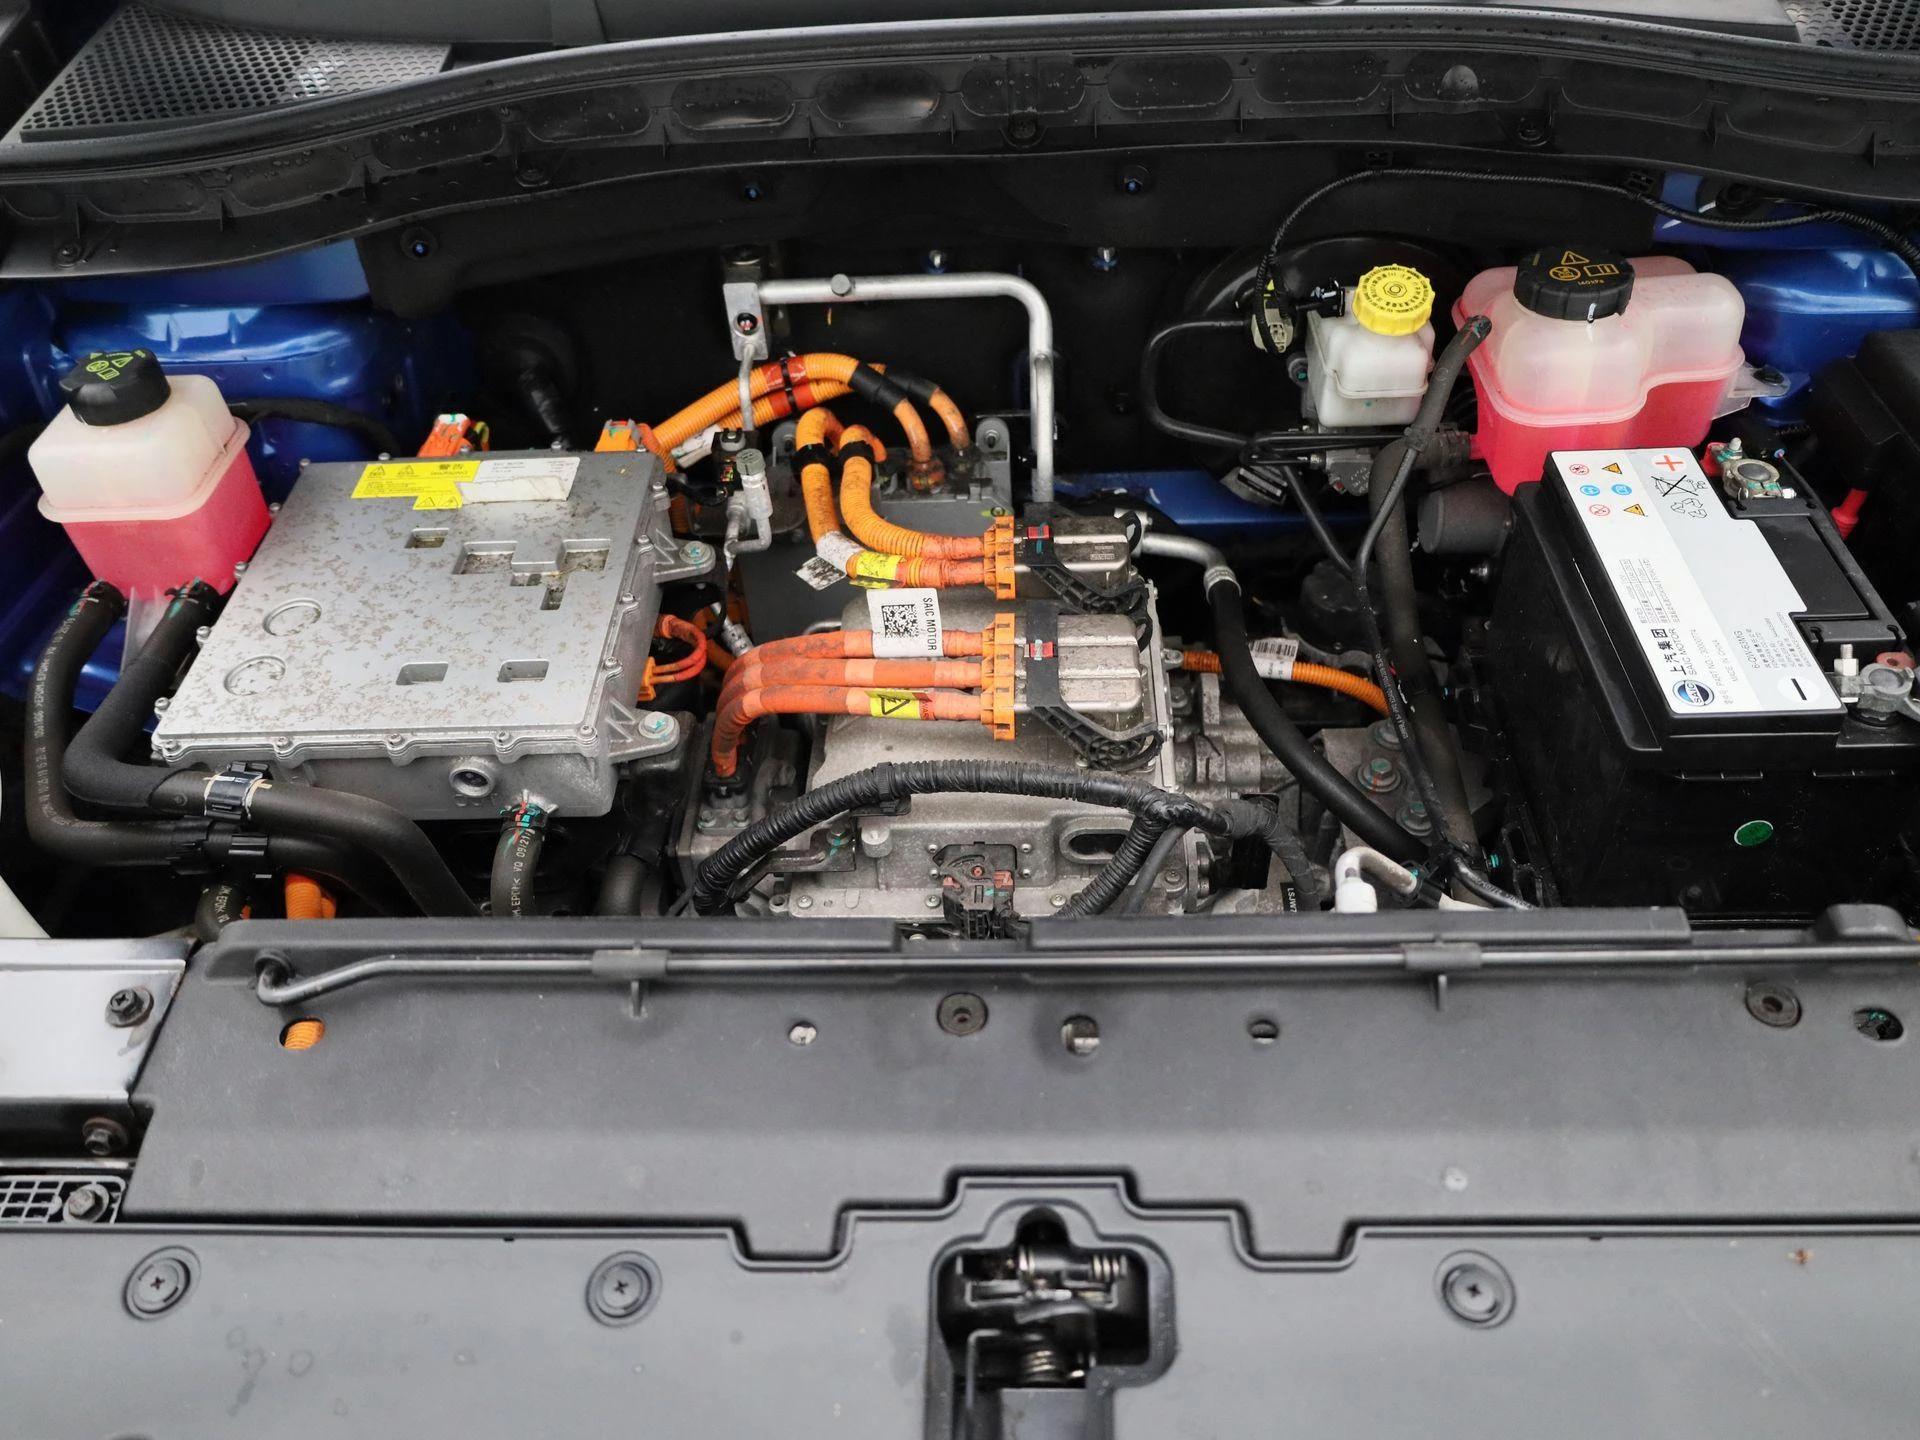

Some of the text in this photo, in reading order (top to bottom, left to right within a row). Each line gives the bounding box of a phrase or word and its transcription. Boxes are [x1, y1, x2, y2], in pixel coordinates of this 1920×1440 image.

[923, 597, 938, 650] SAIC MOTOR
[1650, 628, 1687, 675] 上汽集团
[1667, 628, 1698, 674] SAIC MOTOR
[1685, 682, 1703, 703] SAIC
